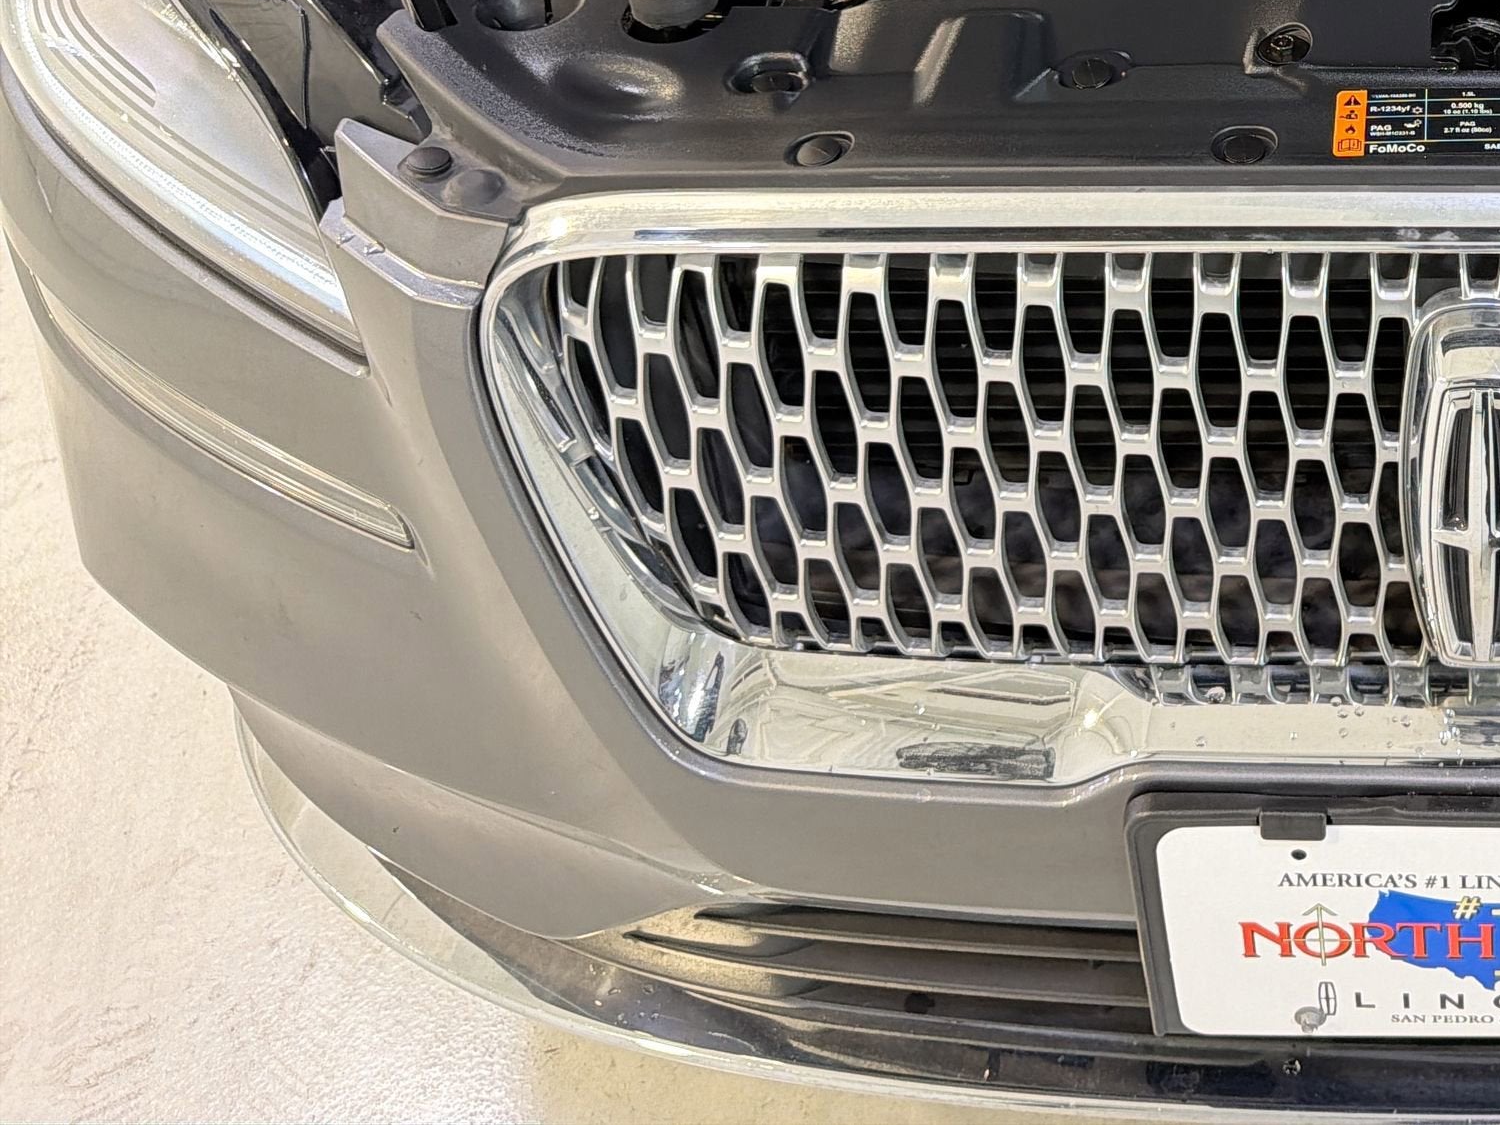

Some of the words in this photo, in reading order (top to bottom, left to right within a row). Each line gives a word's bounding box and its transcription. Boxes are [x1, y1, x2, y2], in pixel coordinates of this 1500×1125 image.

[1369, 105, 1411, 113] R-1234yf
[1369, 143, 1426, 153] FoMoCo
[1278, 873, 1417, 889] AMERICA'S
[1424, 874, 1451, 889] #1
[1238, 921, 1496, 959] NORTH
[1391, 1014, 1426, 1024] SAN
[1432, 1014, 1494, 1024] PEDRO
